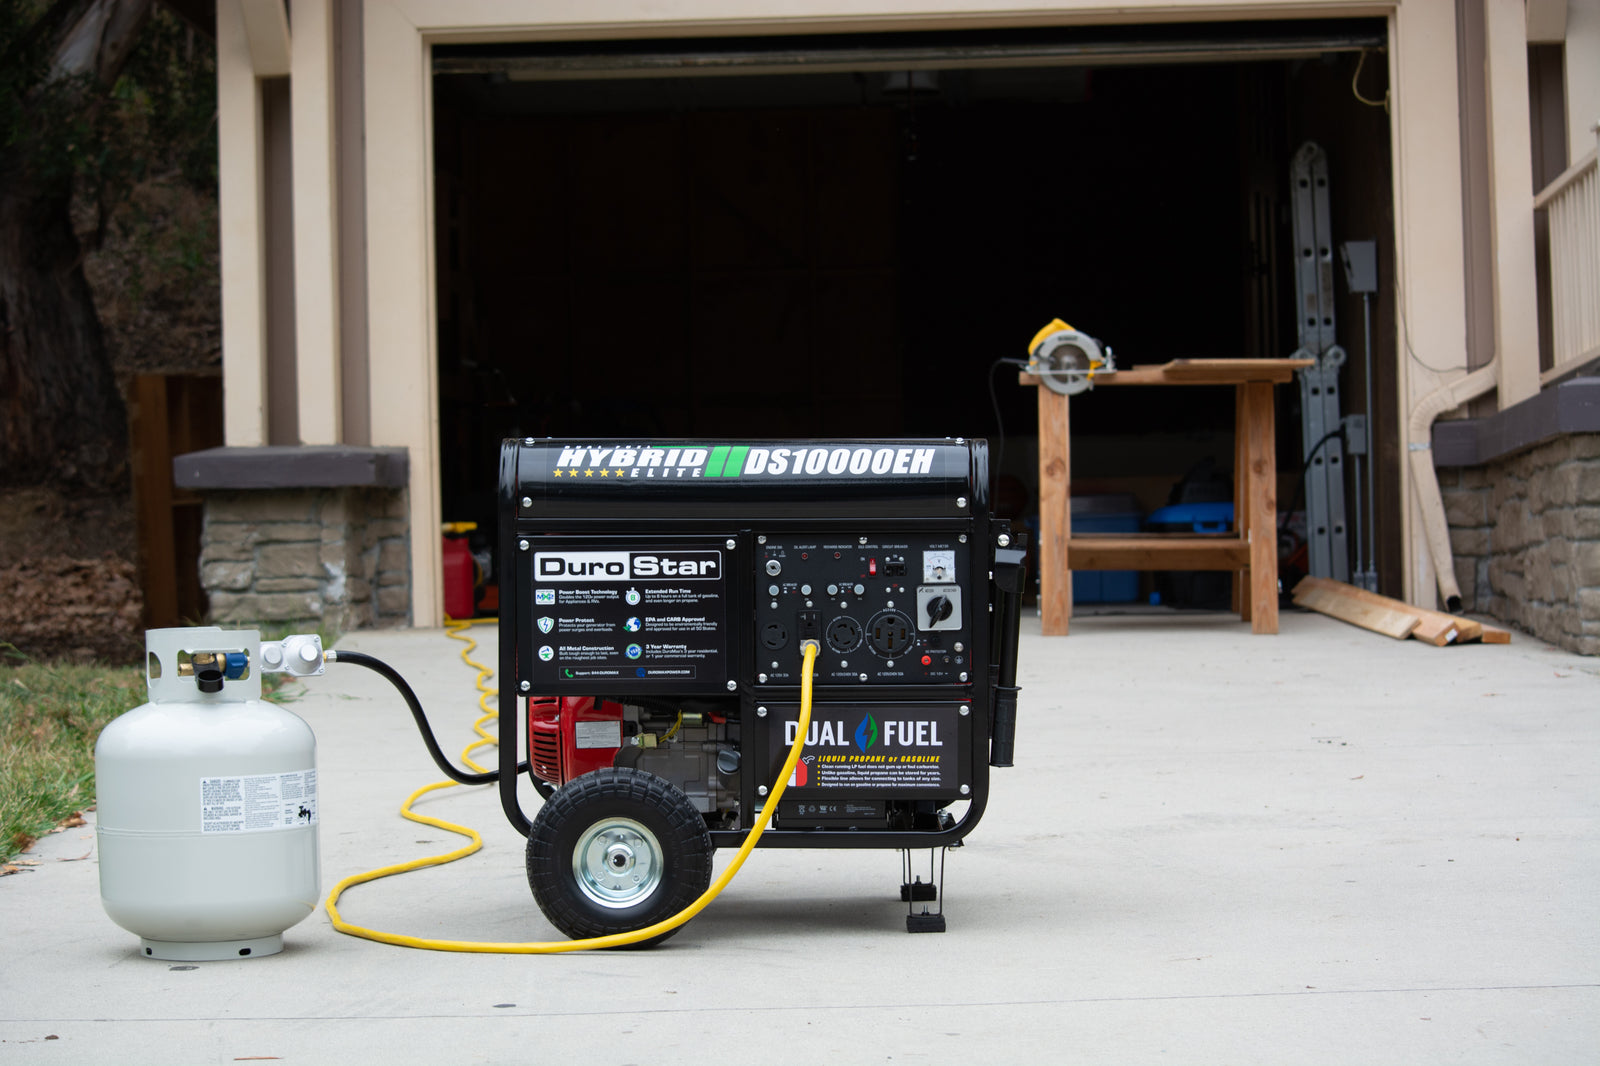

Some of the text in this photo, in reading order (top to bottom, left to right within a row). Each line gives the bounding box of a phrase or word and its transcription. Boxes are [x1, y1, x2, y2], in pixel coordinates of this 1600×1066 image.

[556, 448, 935, 475] HYBRID DS10000EH
[630, 468, 702, 477] ELITE
[785, 721, 943, 746] DUAL FUEL
